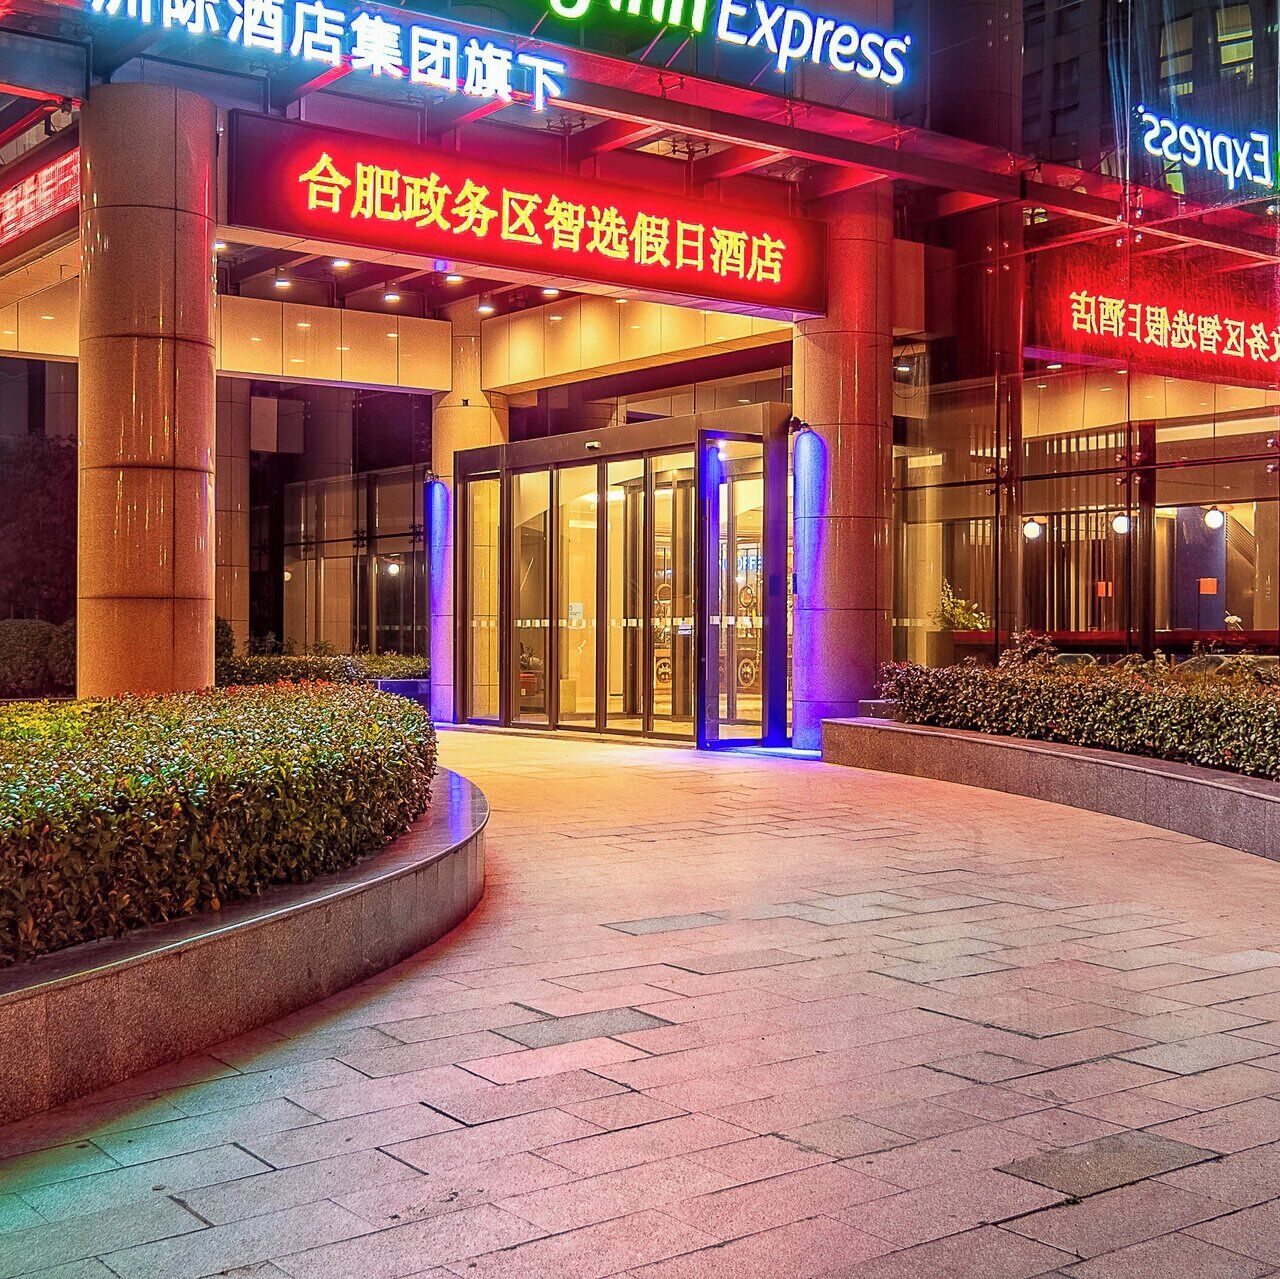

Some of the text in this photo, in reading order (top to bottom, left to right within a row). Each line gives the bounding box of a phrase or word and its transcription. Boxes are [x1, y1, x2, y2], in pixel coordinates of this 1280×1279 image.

[298, 151, 787, 284] 合肥政务区智选假日酒店
